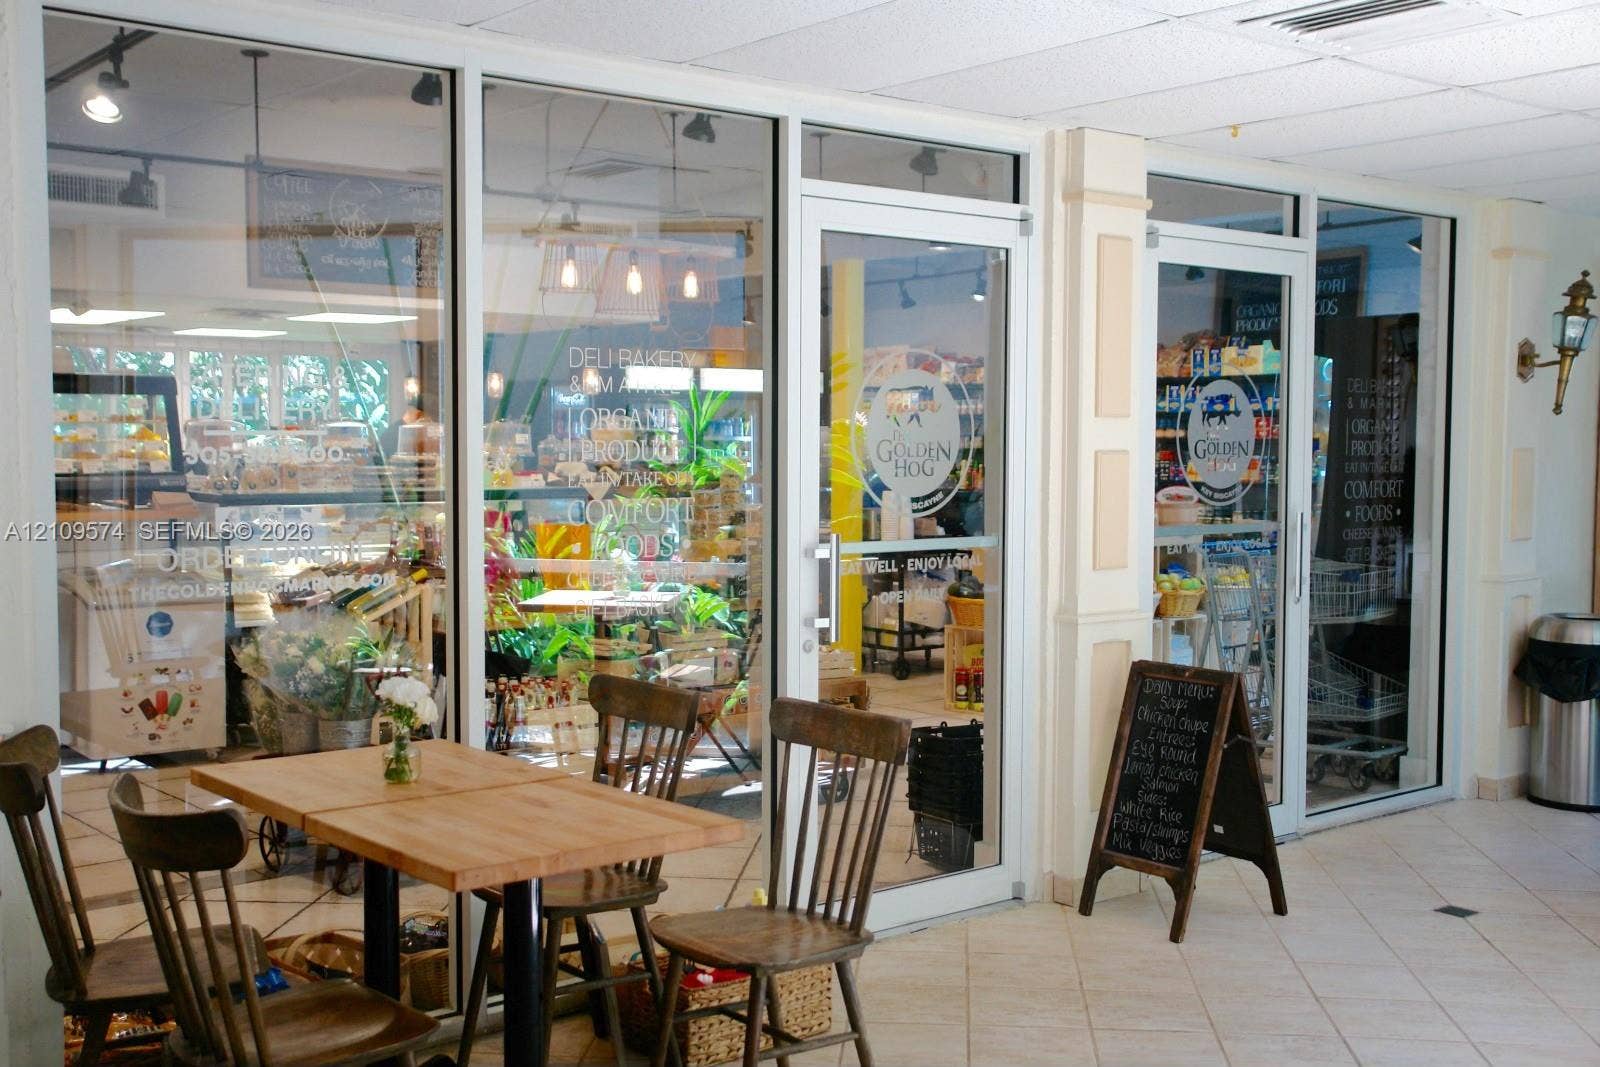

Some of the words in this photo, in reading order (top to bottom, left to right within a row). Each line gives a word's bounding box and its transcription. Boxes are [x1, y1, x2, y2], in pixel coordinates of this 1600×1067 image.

[569, 347, 612, 368] DELI
[619, 349, 697, 370] BAKERY
[570, 375, 581, 394] &
[876, 439, 951, 463] GOLDEN
[1194, 439, 1249, 461] GOLDEN
[895, 458, 935, 478] HOG
[1344, 479, 1404, 500] COMFORT
[568, 497, 696, 526] COMFORT
[1355, 504, 1393, 523] FOODS
[865, 559, 899, 574] WELL
[907, 556, 945, 573] ENJOY
[880, 589, 911, 605] OPEN
[1148, 727, 1196, 748] Entrees:
[1137, 790, 1168, 806] Sides:
[1160, 807, 1183, 824] Rice
